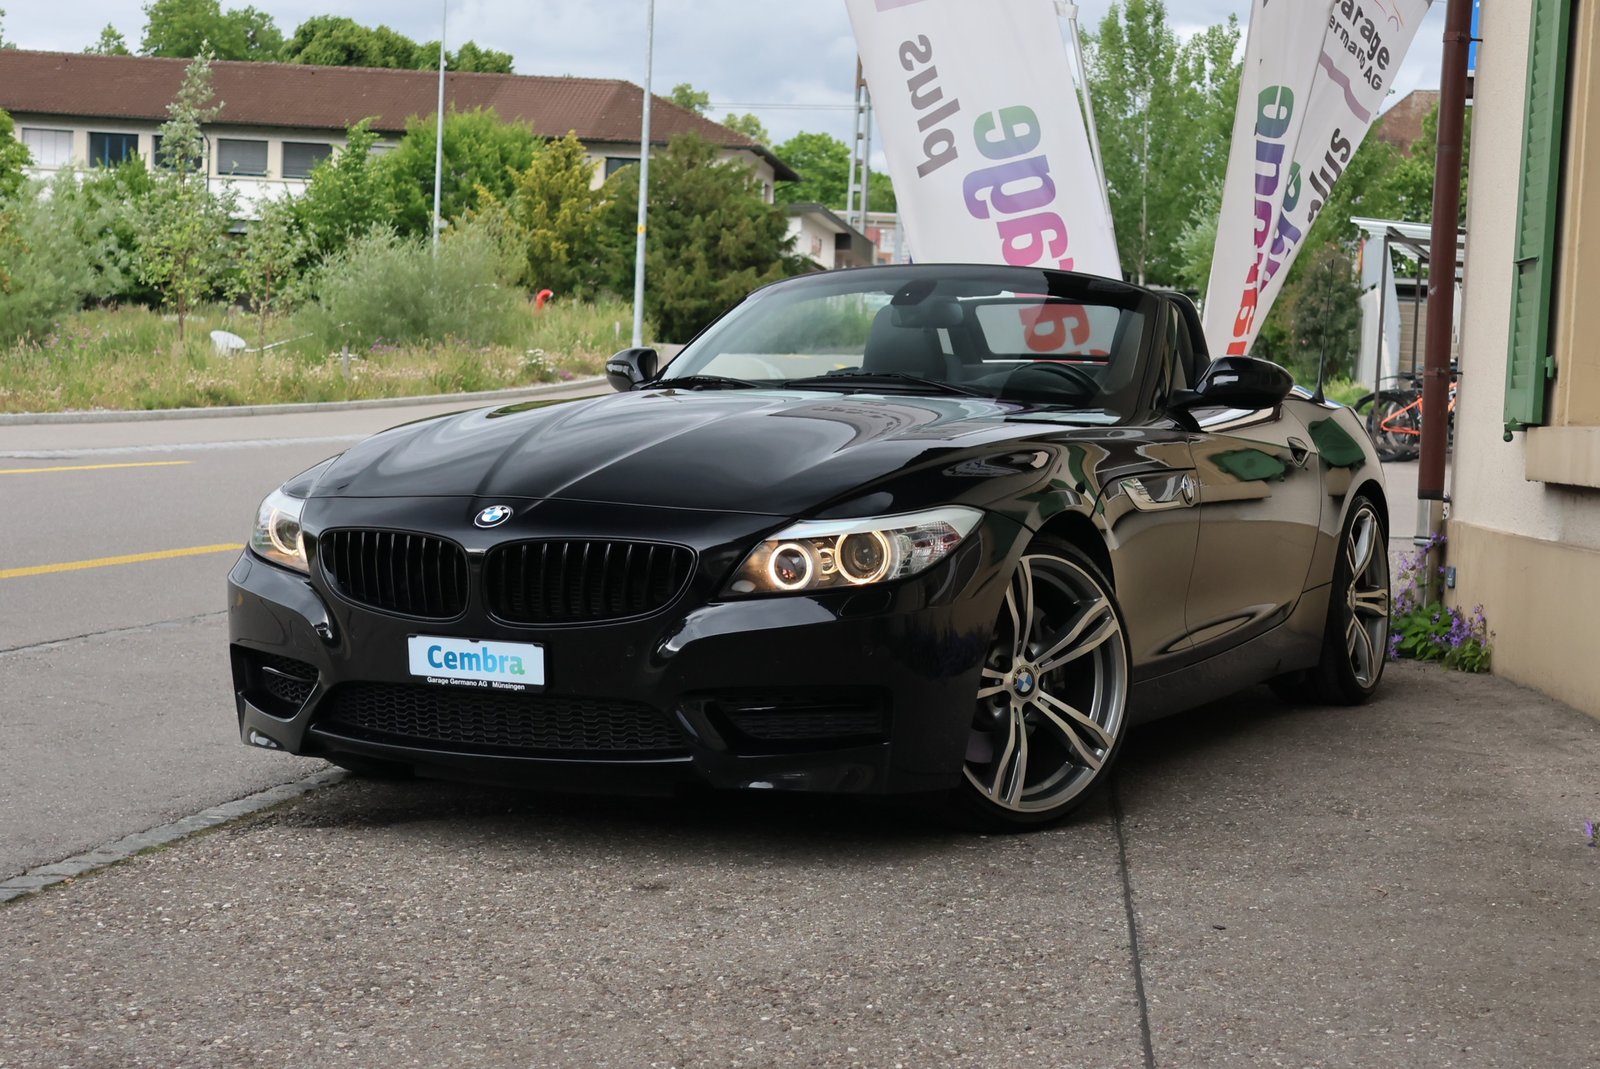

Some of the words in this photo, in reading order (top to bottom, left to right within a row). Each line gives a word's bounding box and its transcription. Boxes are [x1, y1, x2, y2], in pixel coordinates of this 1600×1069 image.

[1328, 15, 1366, 70] ermano
[1363, 65, 1382, 91] AG
[1335, 0, 1390, 70] arage
[427, 645, 525, 675] Cembra
[427, 676, 449, 684] Garage
[450, 678, 477, 687] Germano
[492, 681, 525, 690] Münsingen
